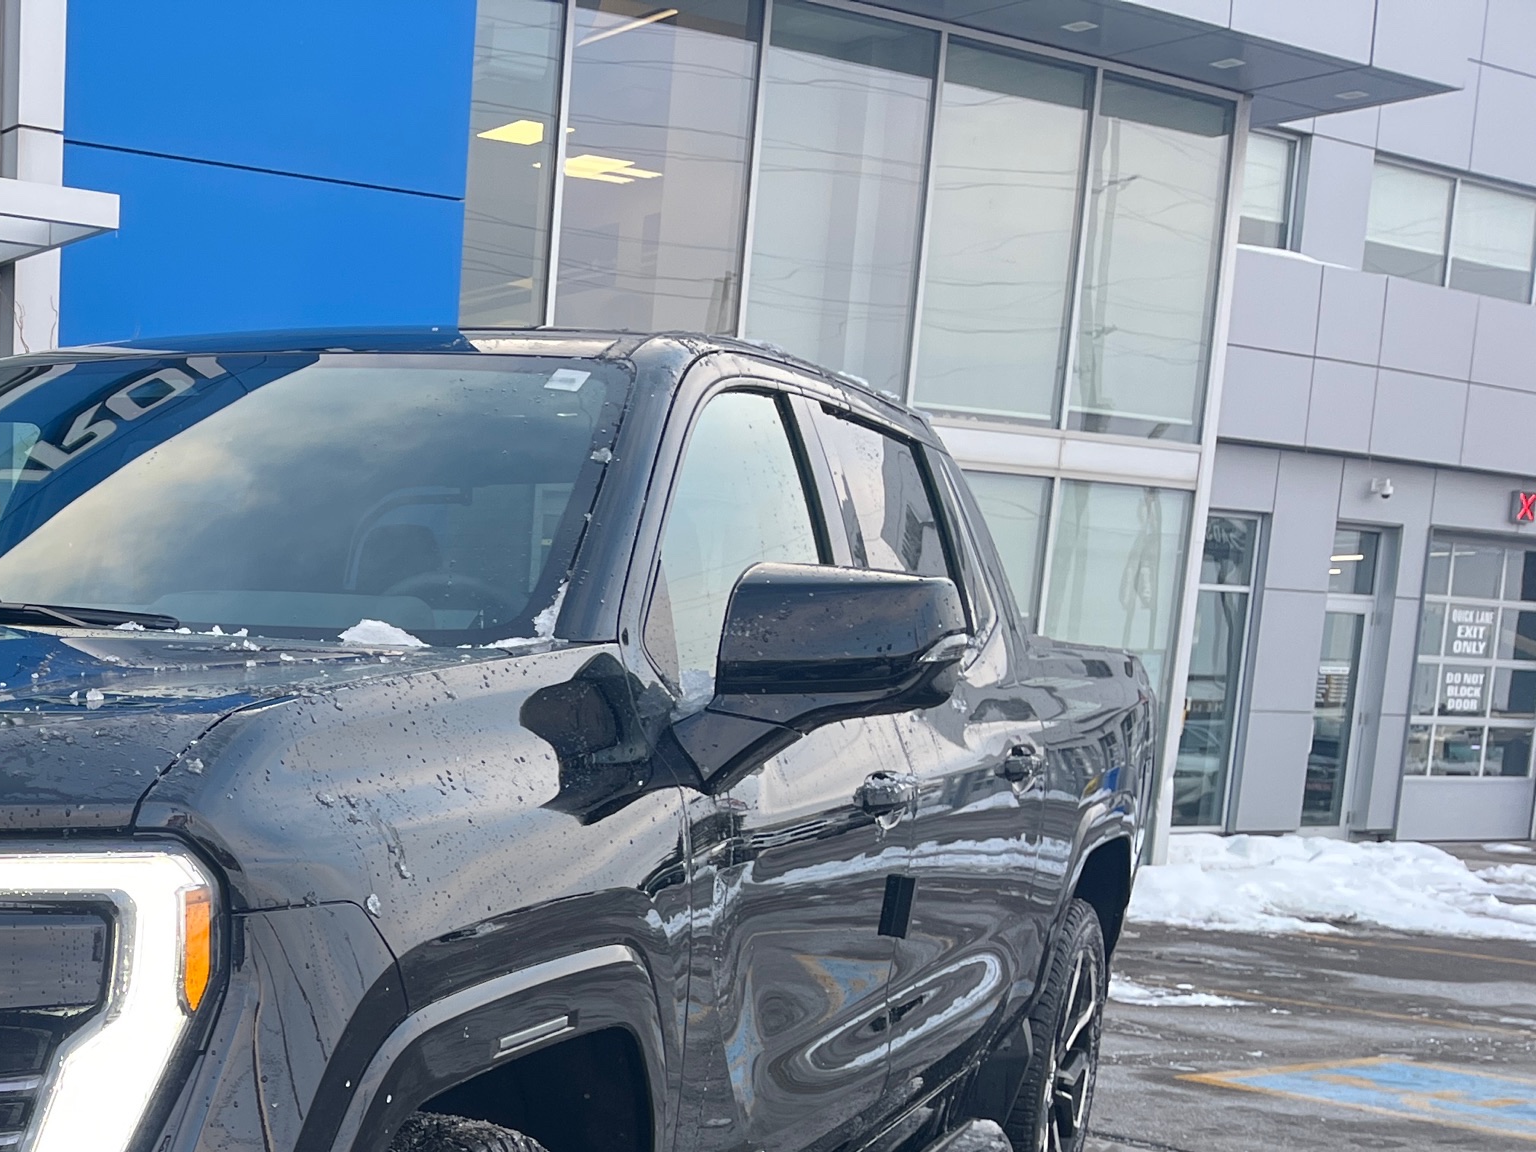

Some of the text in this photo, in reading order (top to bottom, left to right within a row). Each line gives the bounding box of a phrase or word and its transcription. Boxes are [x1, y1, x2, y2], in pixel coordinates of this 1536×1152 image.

[1452, 609, 1495, 624] QUICK LANE
[1456, 625, 1486, 640] EXIT
[1452, 640, 1487, 655] ONLY
[1445, 672, 1485, 685] DO NOT
[1446, 685, 1482, 698] BLOCK
[1447, 698, 1478, 711] DOOR
